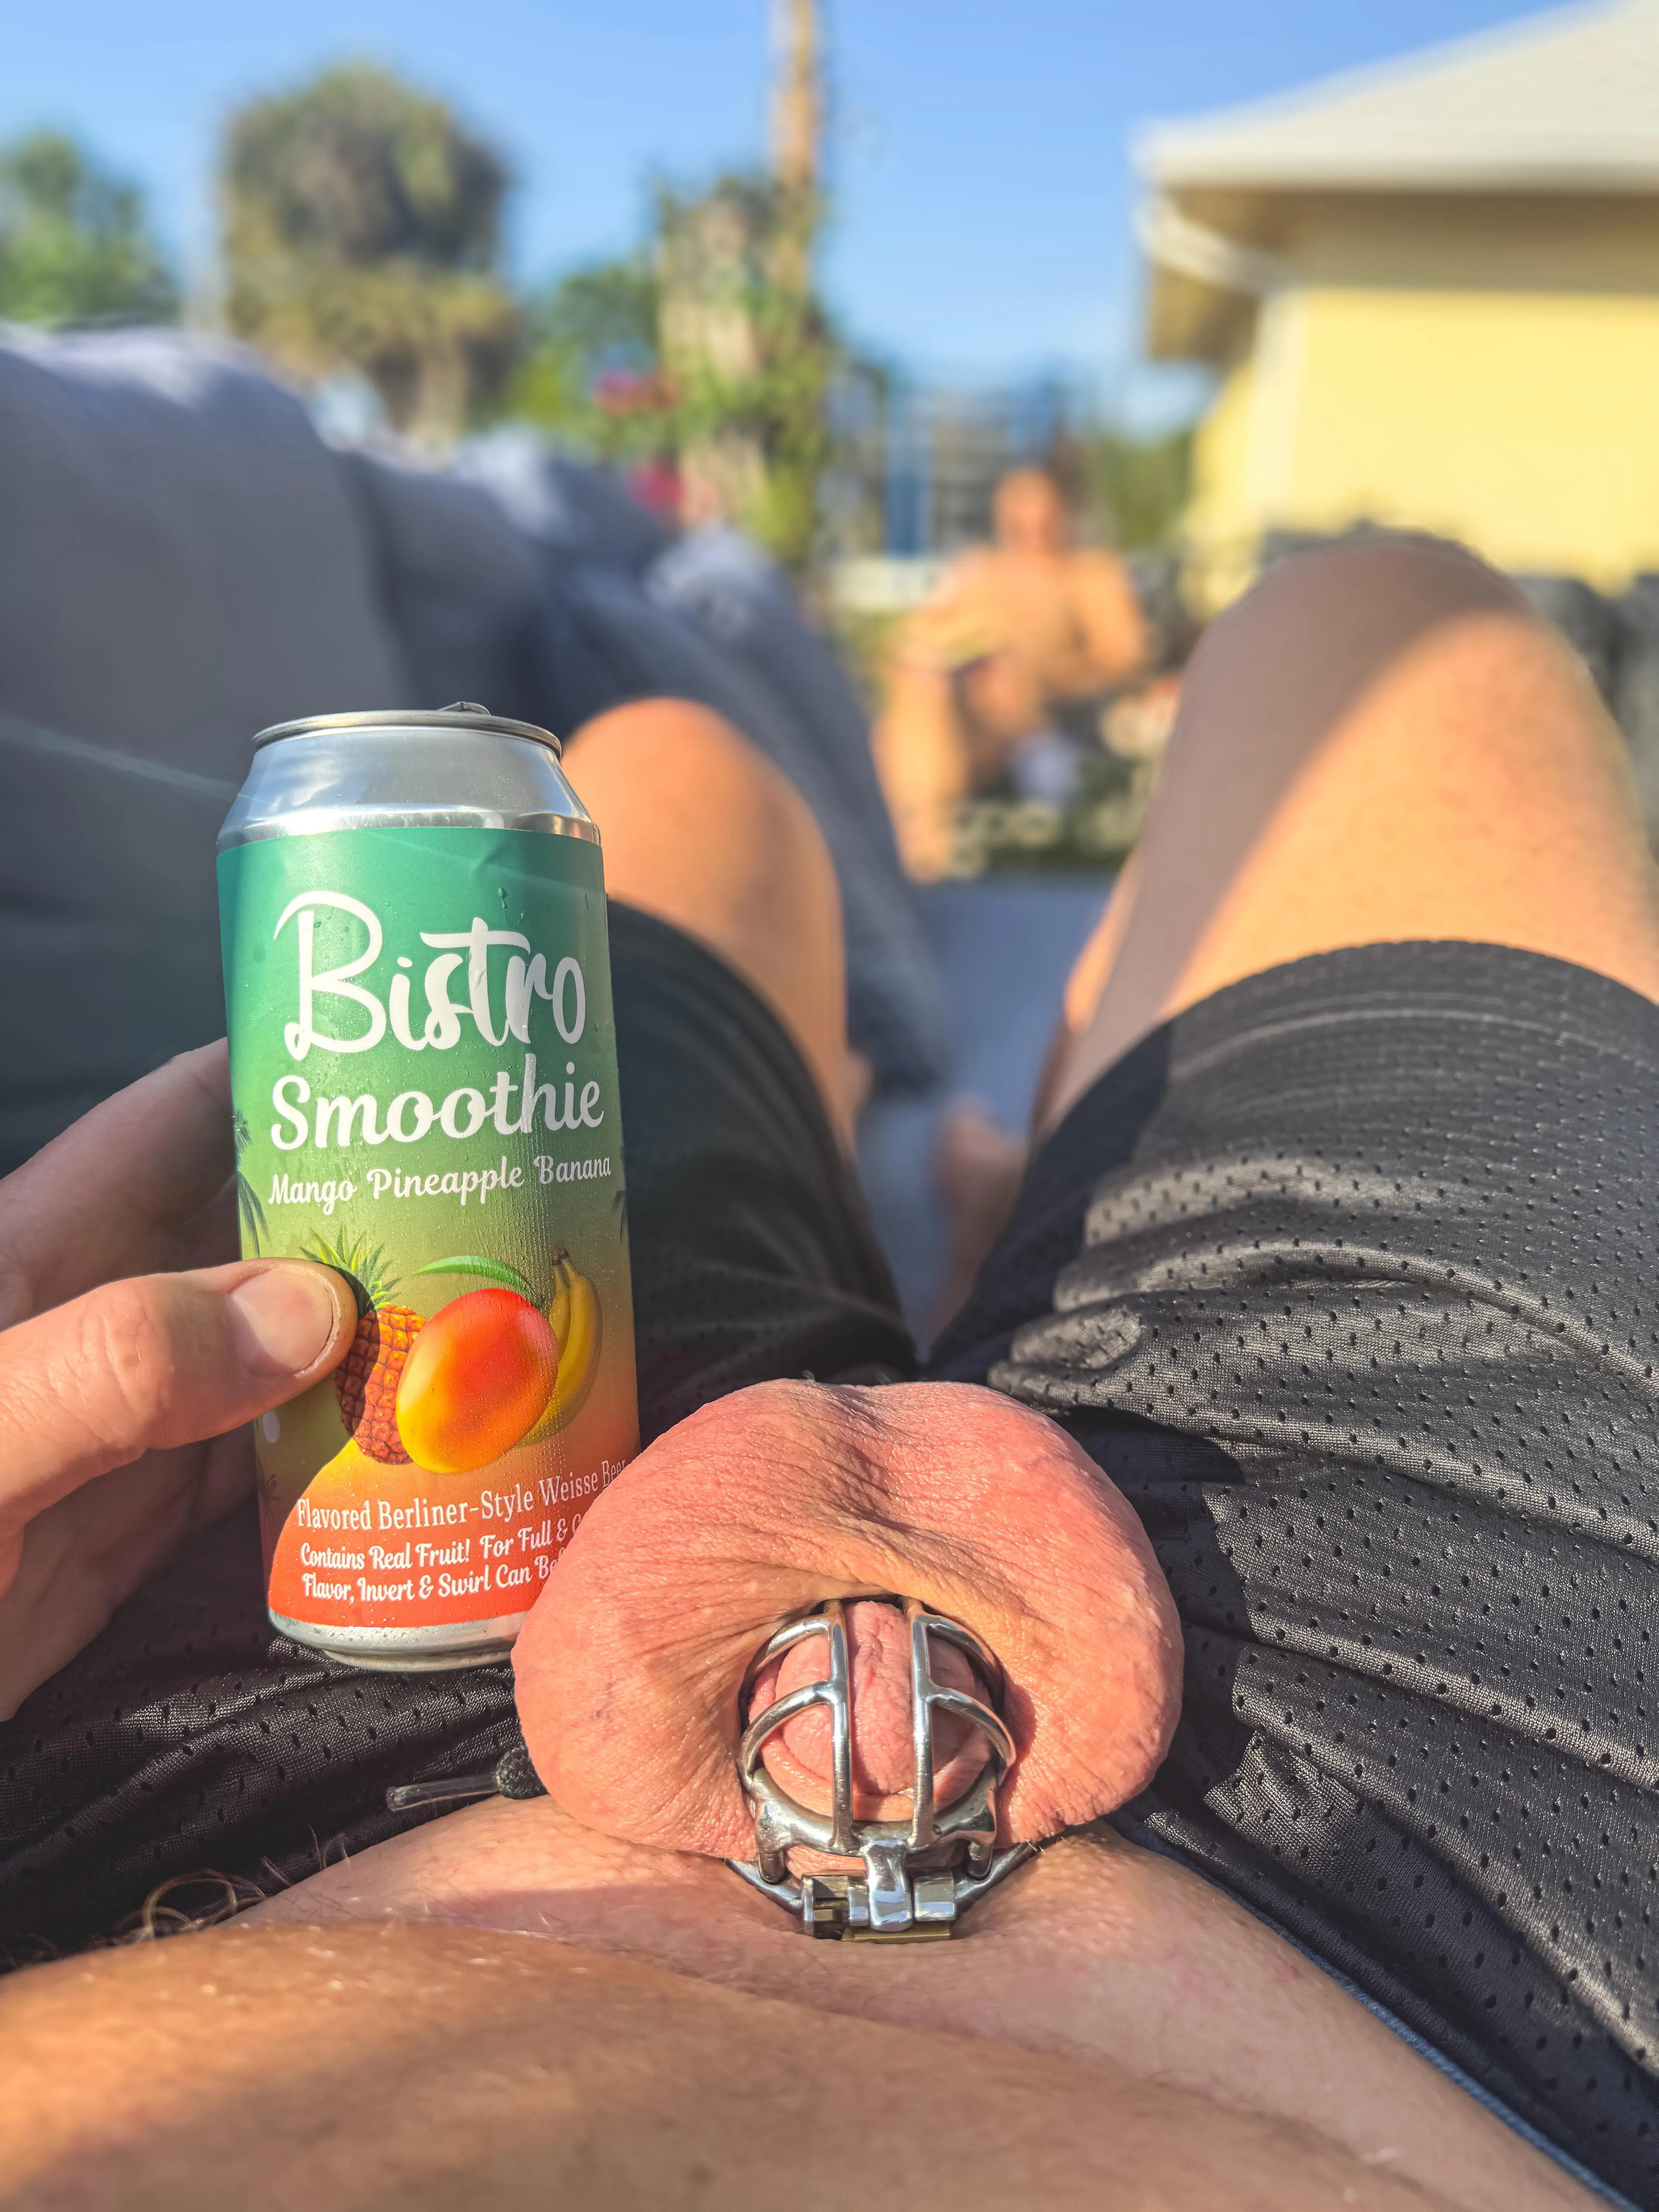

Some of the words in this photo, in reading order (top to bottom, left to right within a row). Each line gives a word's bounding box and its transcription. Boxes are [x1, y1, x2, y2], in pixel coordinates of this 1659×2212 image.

[273, 891, 586, 1061] Bistro
[271, 1053, 604, 1151] Smoothie
[269, 1173, 357, 1216] Mango
[366, 1155, 524, 1206] Pineapple
[534, 1155, 612, 1184] Banana
[297, 1498, 372, 1530] Flavored
[377, 1483, 534, 1530] Berliner-Style
[539, 1472, 598, 1506] Weisse
[301, 1542, 366, 1569] Contains
[368, 1541, 414, 1569] Real
[415, 1538, 471, 1568] Fruit!
[479, 1534, 514, 1559] For
[517, 1519, 553, 1551] Full
[556, 1518, 568, 1542] &
[301, 1571, 354, 1605] Flavor,
[356, 1577, 415, 1602] Invert
[418, 1575, 434, 1600] &
[438, 1564, 492, 1597] Swirl
[496, 1564, 532, 1588] Can
